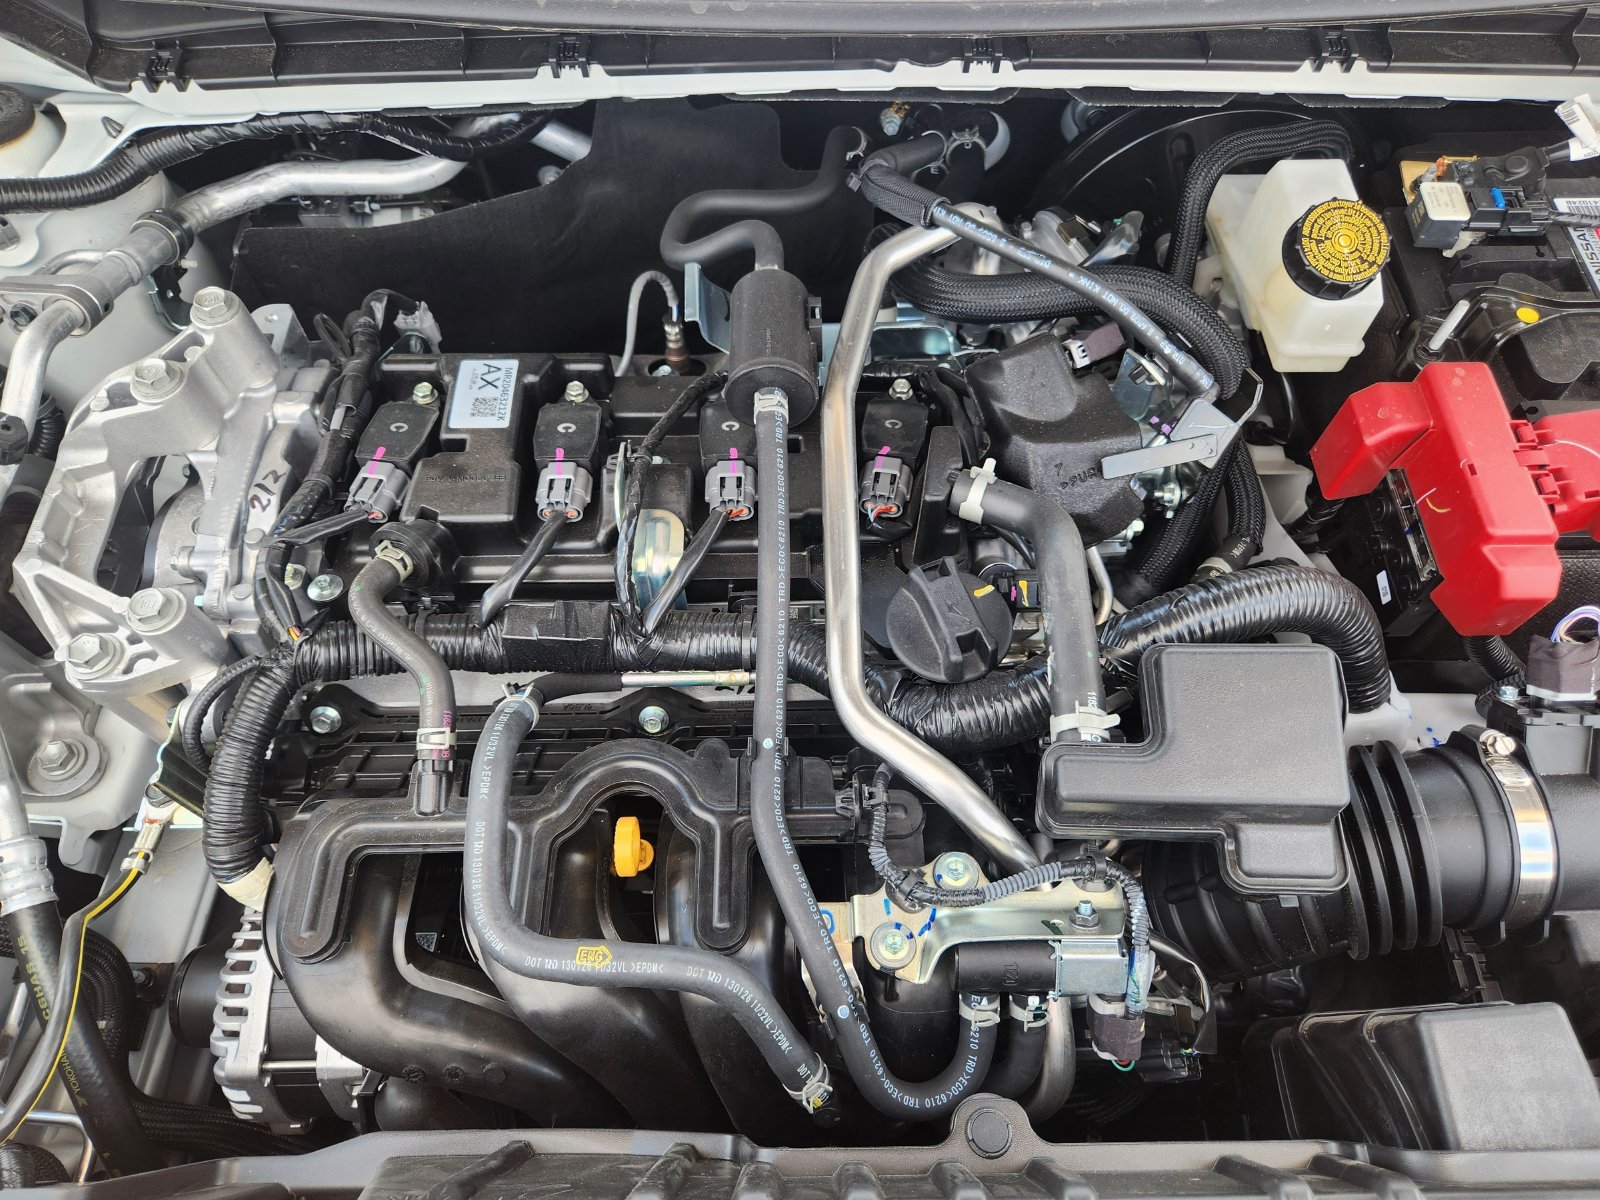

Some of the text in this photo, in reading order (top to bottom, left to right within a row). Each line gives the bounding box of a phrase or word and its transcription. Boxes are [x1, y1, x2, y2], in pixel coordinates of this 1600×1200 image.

[1076, 274, 1100, 294] KINK
[1101, 289, 1119, 305] NOT
[478, 363, 502, 390] AX
[478, 764, 492, 799] >EPDM<
[474, 821, 485, 836] DOT
[472, 858, 482, 888] 130126
[481, 926, 508, 955] >EPDM<
[524, 955, 541, 968] DOT
[580, 950, 603, 963] ENG
[631, 963, 662, 972] >EPDM<
[686, 965, 704, 978] DOT
[723, 977, 753, 1003] 130126
[768, 1025, 792, 1053] >EPDM<
[796, 1063, 811, 1079] DOT
